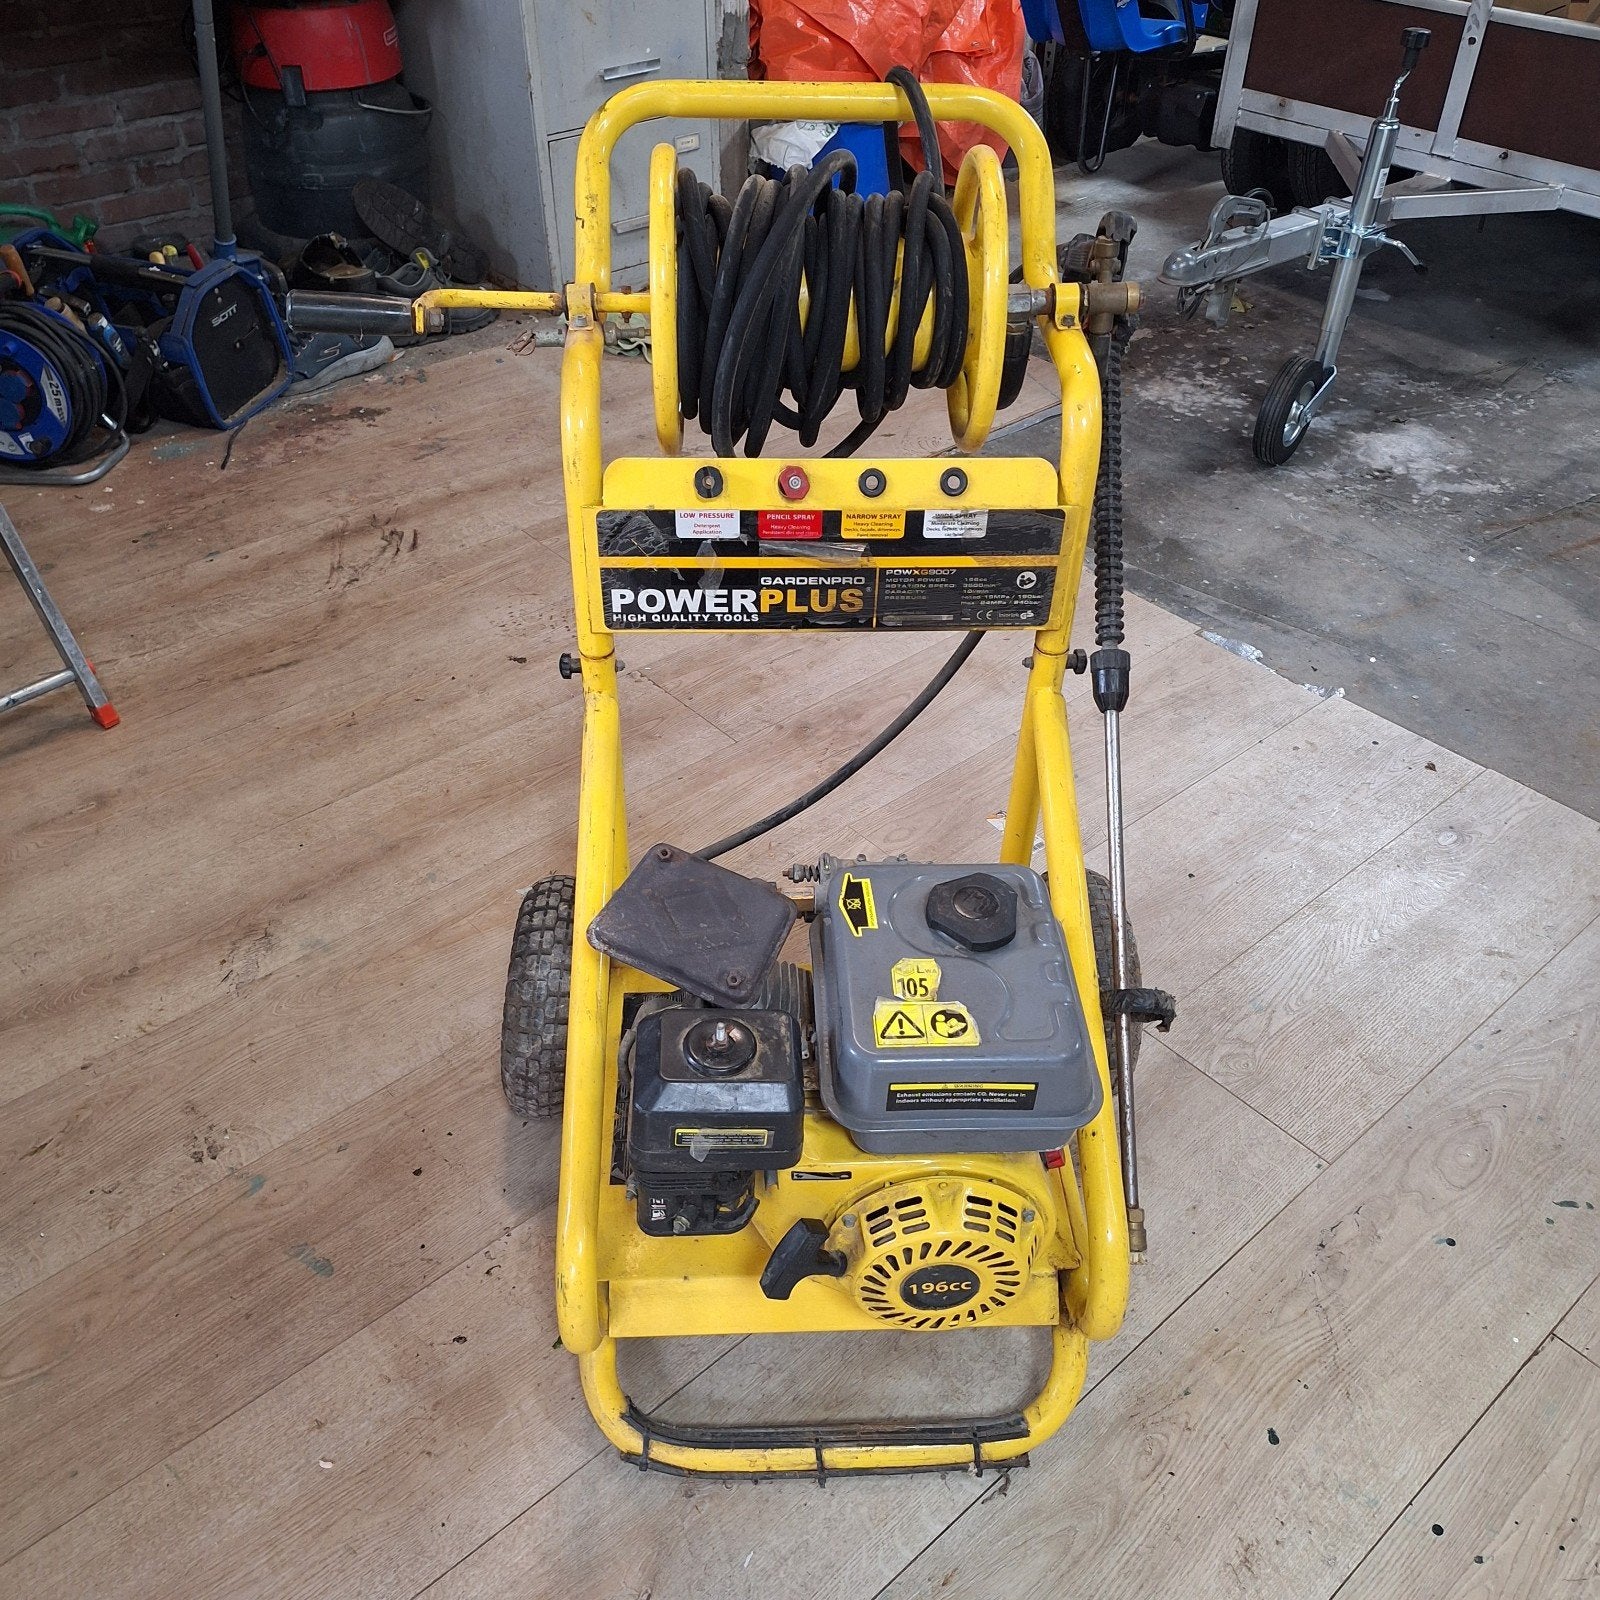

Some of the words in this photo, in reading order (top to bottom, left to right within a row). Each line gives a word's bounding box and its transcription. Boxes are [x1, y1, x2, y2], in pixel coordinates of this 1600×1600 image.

[49, 380, 62, 397] 25
[885, 568, 957, 576] POWXG9007
[760, 576, 866, 586] GARDENPRO
[611, 588, 864, 613] POWERPLUS
[613, 613, 647, 622] HIGH
[651, 613, 710, 622] QUALITY
[715, 613, 759, 622] TOOLS
[897, 977, 929, 998] 105
[909, 1281, 972, 1295] 196cc
